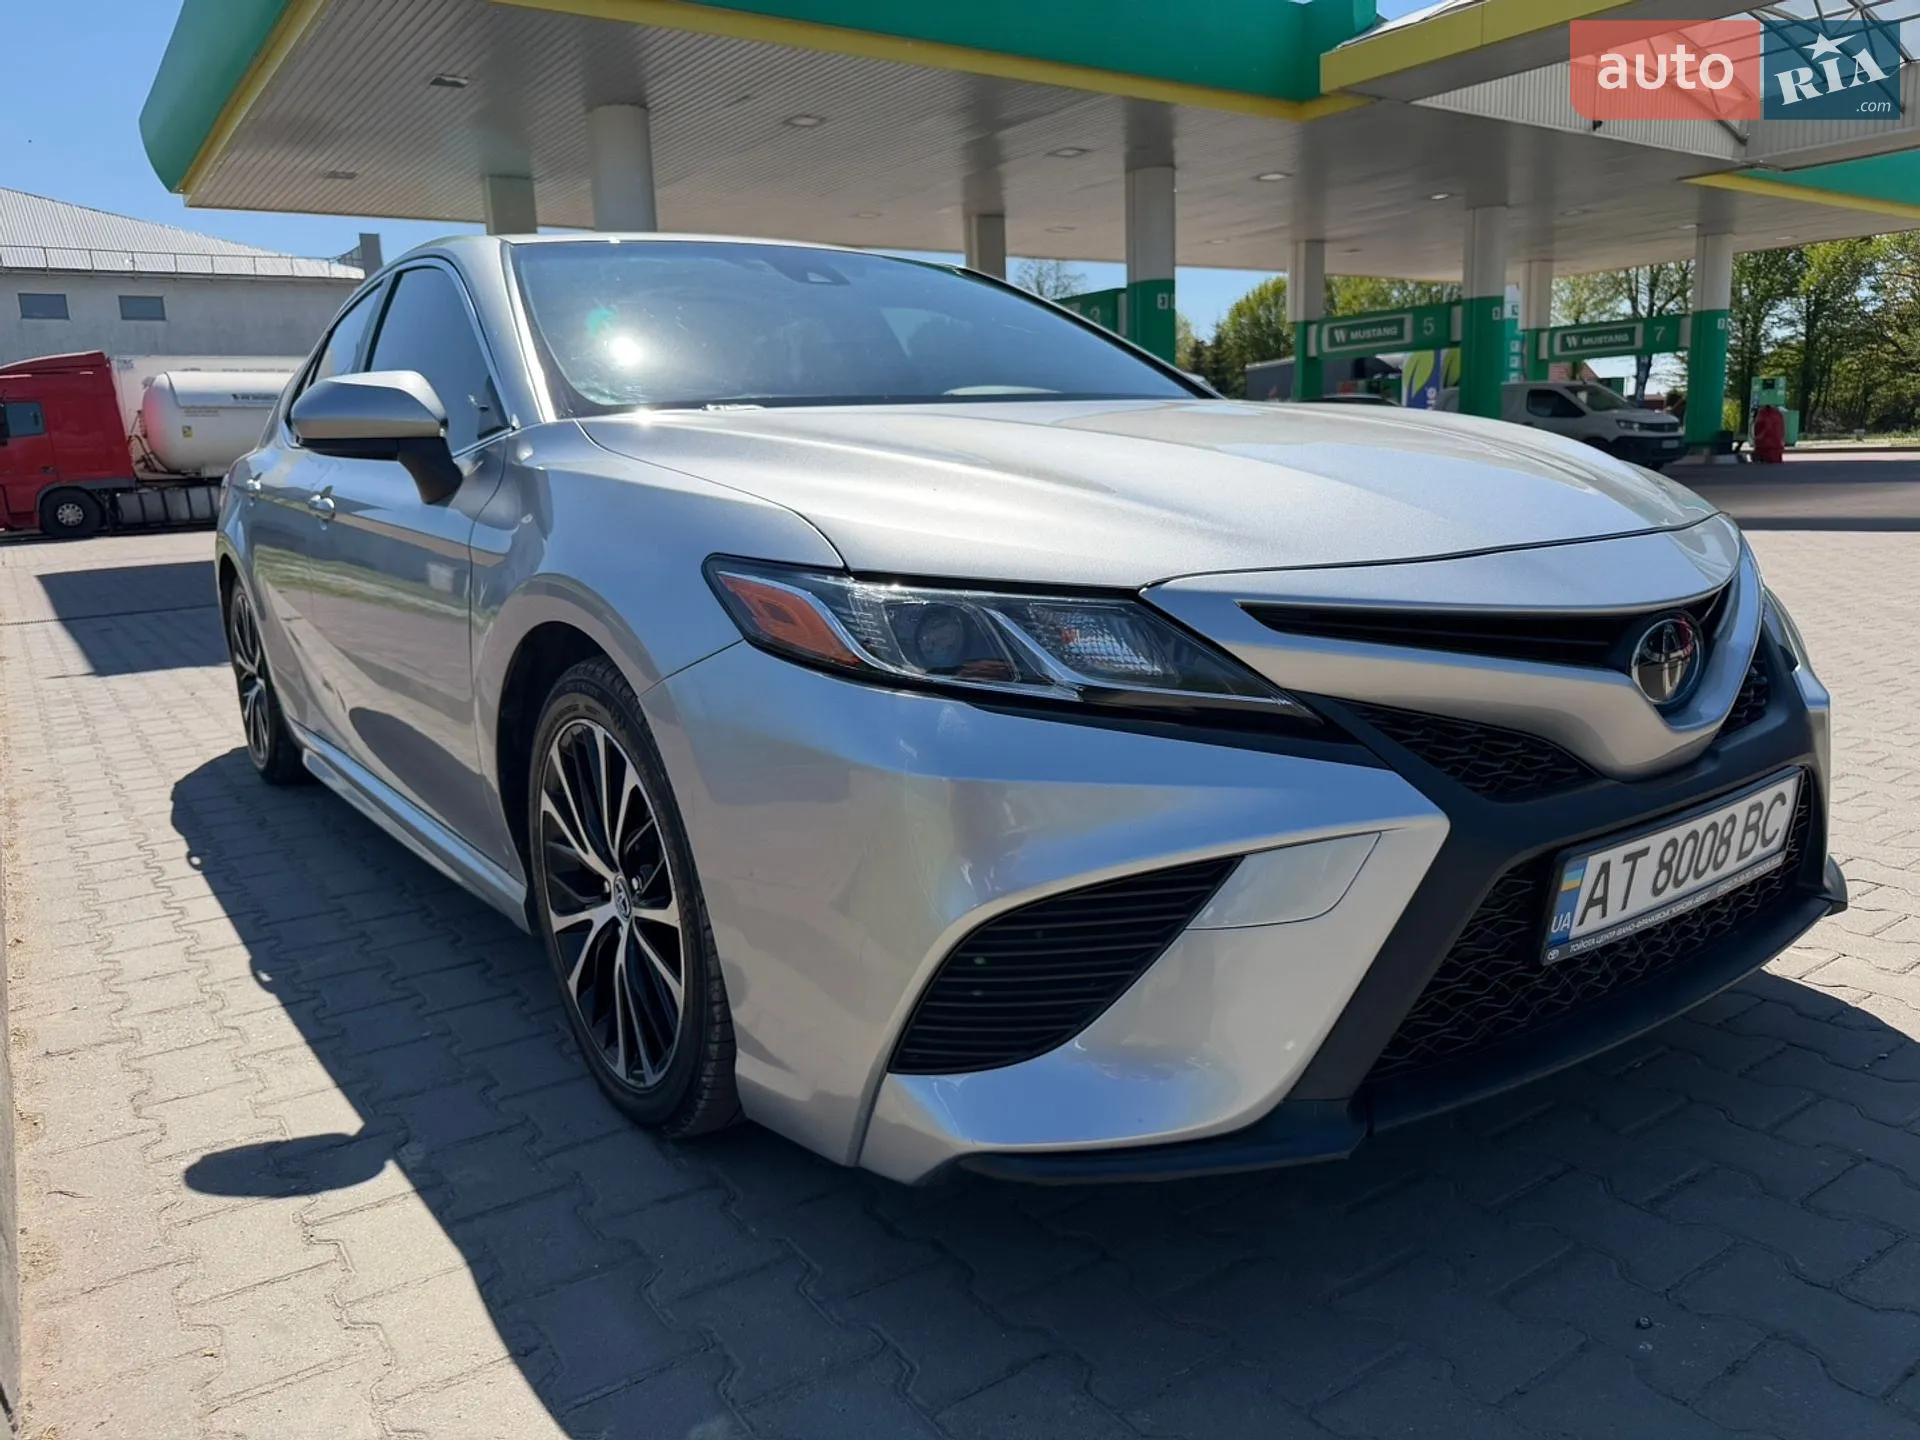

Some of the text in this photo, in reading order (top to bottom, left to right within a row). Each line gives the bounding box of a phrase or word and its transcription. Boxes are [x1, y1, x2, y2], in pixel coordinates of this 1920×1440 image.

[1350, 325, 1398, 341] MUSTANG
[1423, 316, 1435, 336] 5
[1654, 325, 1666, 342] 7
[1582, 333, 1630, 347] MUSTANG
[1577, 846, 1650, 926] AT
[1651, 813, 1737, 898] 8008
[1736, 791, 1787, 861] BC
[1551, 911, 1571, 933] UA
